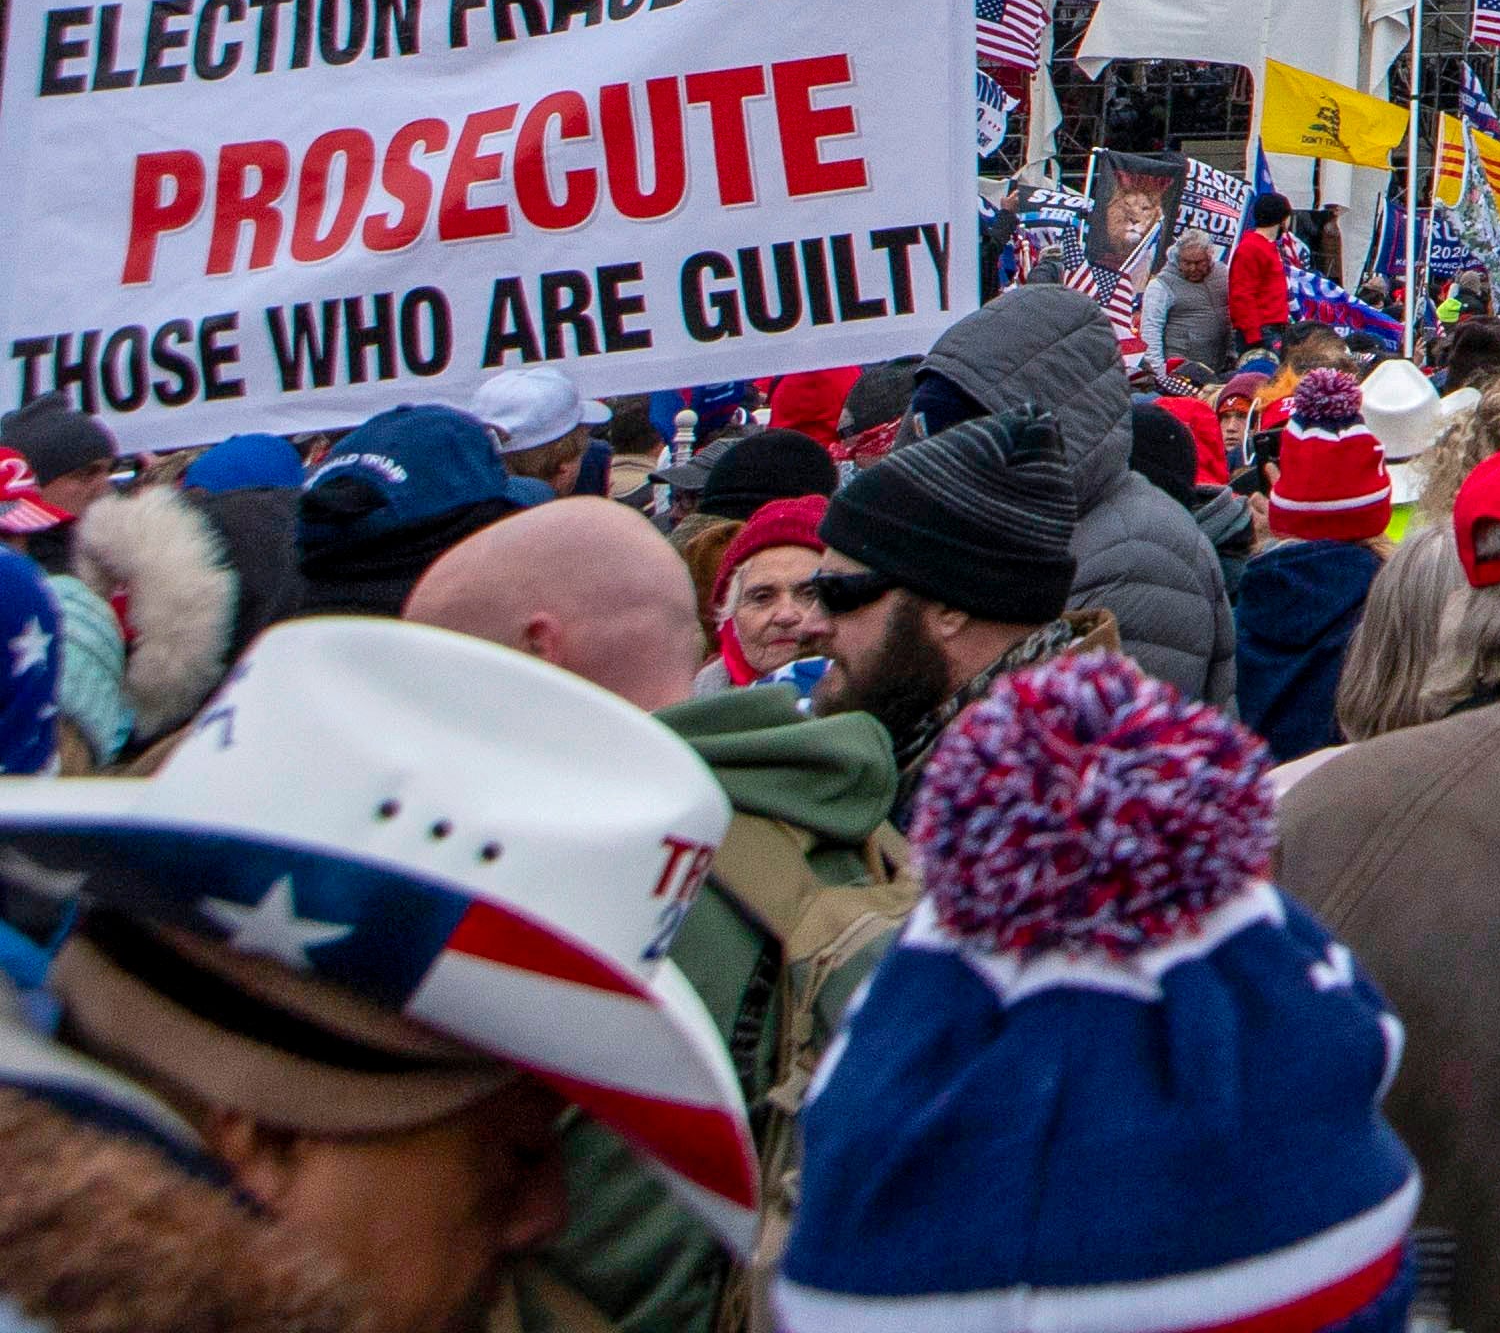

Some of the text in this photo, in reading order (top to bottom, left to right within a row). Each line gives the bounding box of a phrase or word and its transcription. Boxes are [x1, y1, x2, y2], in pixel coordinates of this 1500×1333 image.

[121, 54, 870, 286] PROSECUTE
[1196, 184, 1217, 200] MY
[1430, 243, 1470, 260] 2020
[11, 222, 951, 416] THOSE WHO ARE GUILTY
[358, 453, 409, 484] TRUMP
